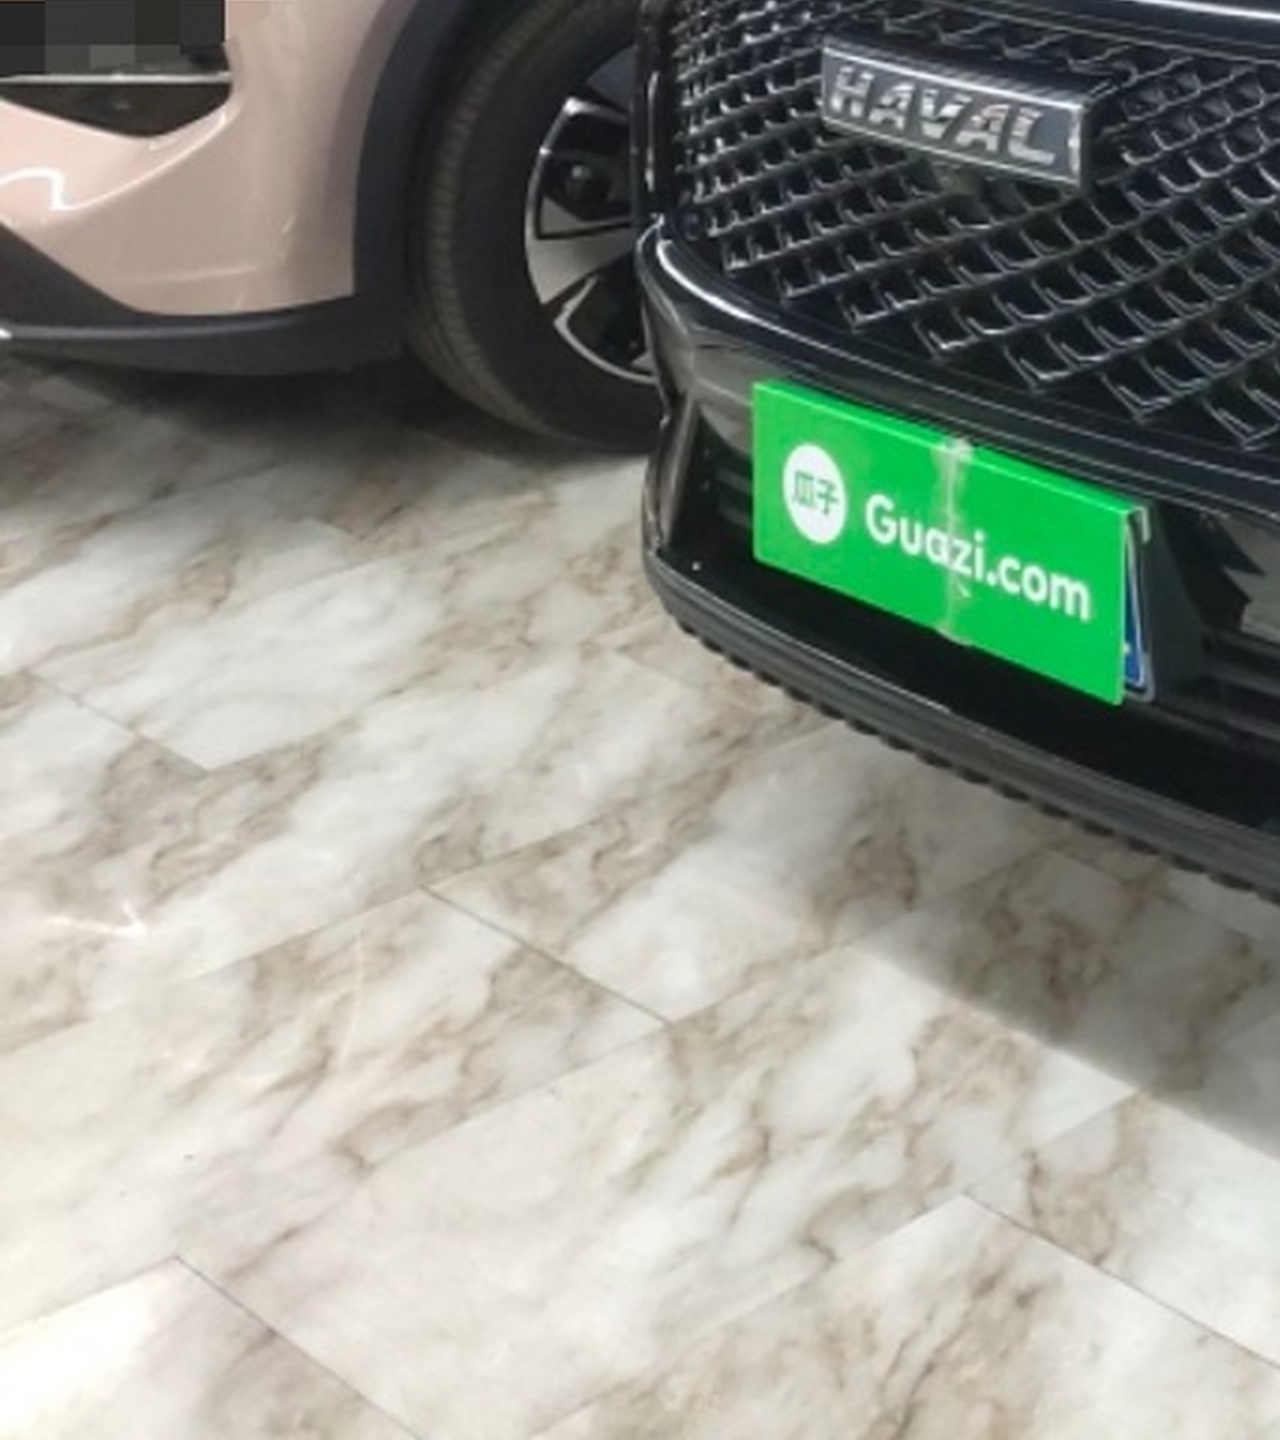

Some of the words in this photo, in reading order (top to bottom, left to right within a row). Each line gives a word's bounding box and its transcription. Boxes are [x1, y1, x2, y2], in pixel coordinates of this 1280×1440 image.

[830, 65, 1055, 165] HAVAL
[793, 469, 840, 516] 瓜子
[865, 493, 1093, 623] Guazi.com
